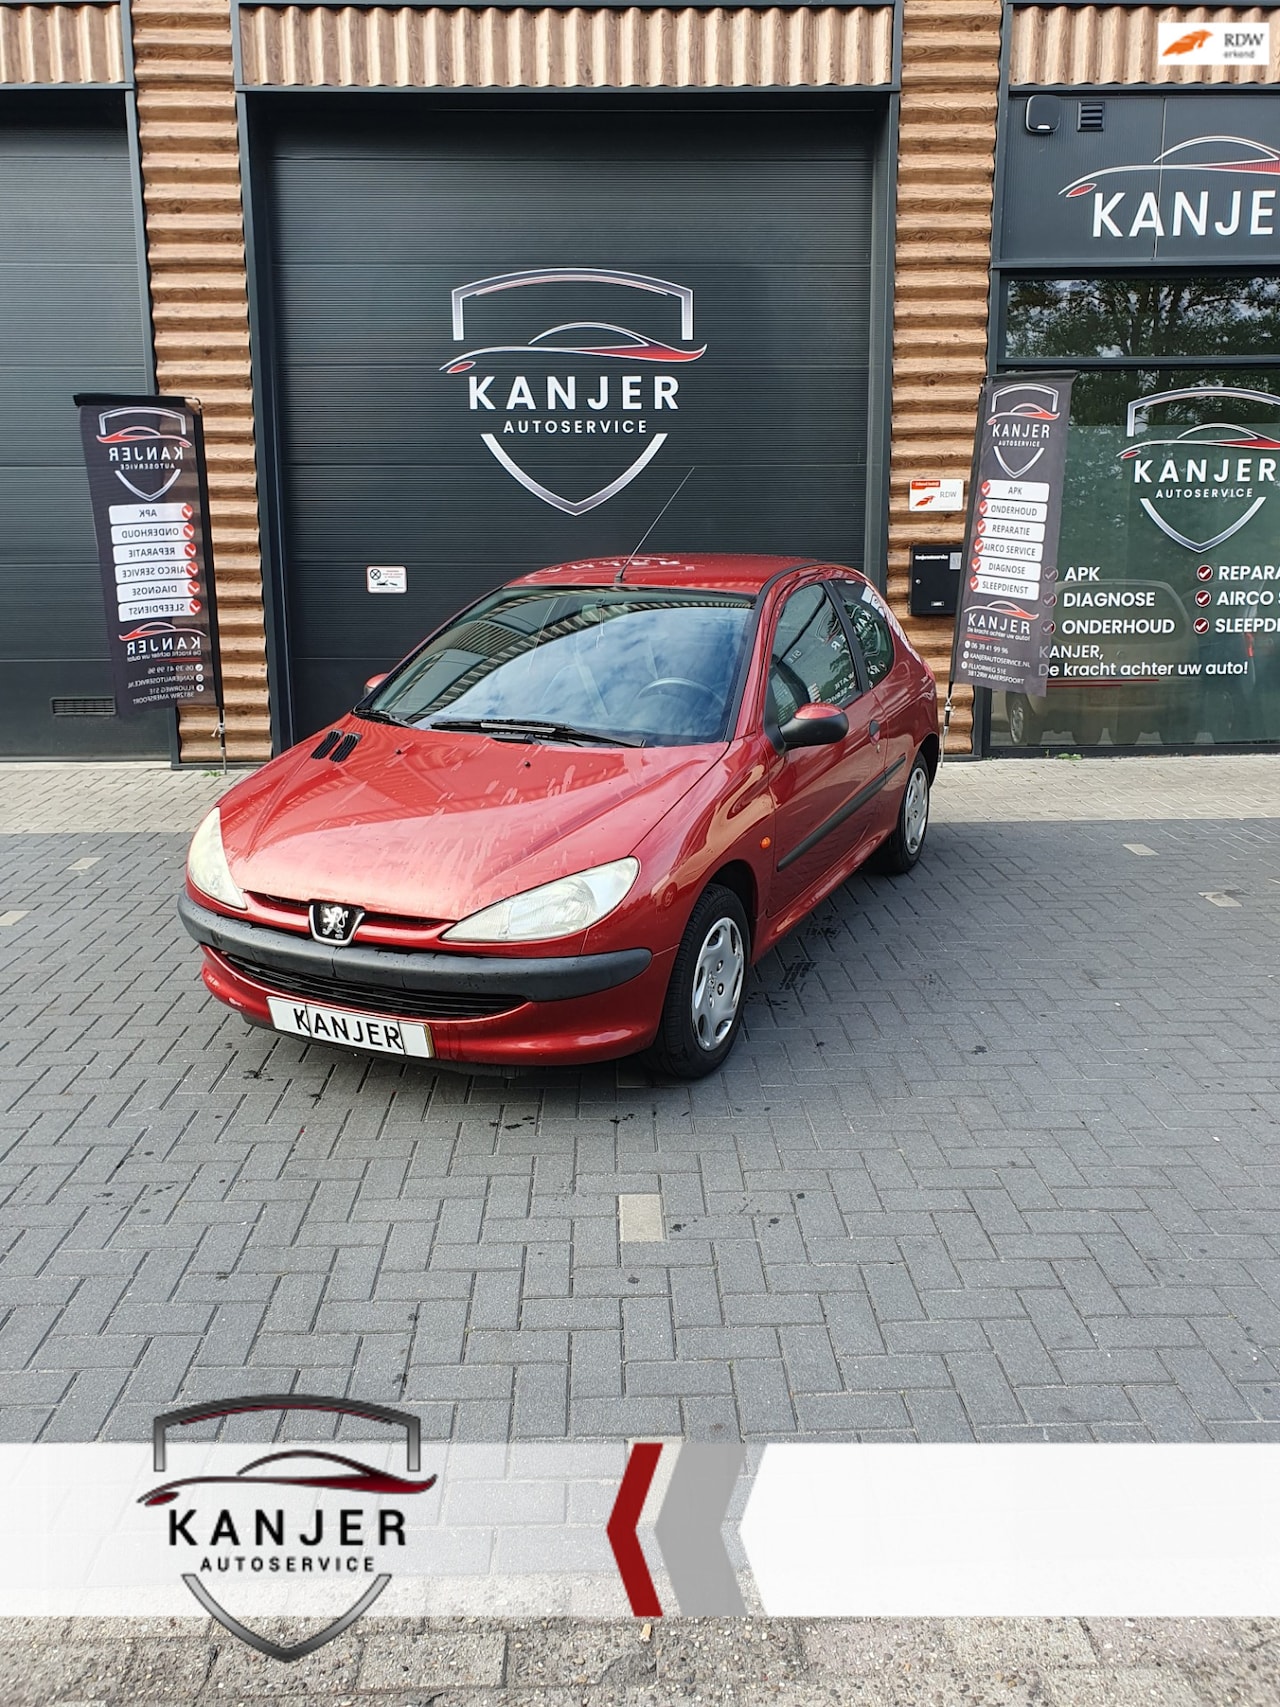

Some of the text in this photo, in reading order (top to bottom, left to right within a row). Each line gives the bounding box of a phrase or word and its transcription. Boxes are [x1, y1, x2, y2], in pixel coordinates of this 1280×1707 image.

[1092, 190, 1276, 237] KANJE
[468, 376, 680, 410] KANJER
[503, 419, 647, 434] AUTOSERVICE
[992, 423, 1050, 438] KANJER
[1134, 458, 1277, 483] KANJER
[1008, 486, 1023, 495] APK
[1155, 488, 1253, 499] AUTOSERVICE
[990, 504, 1038, 517] ONDERHOUD
[991, 524, 1030, 536] REPARATIE
[984, 543, 1036, 556] AIRCO SERVICE
[988, 562, 1026, 575] DIAGNOSE
[1064, 566, 1100, 581] APK
[982, 580, 1029, 595] SLEEPDIENST
[1063, 591, 1155, 608] DIAGNOSE
[1216, 590, 1274, 606] AIRCO
[967, 612, 1031, 635] KANJER
[1061, 619, 1175, 635] ONDERHOUD
[1038, 661, 1248, 677] De kracht achter uw auto!
[293, 1008, 404, 1050] KANJER
